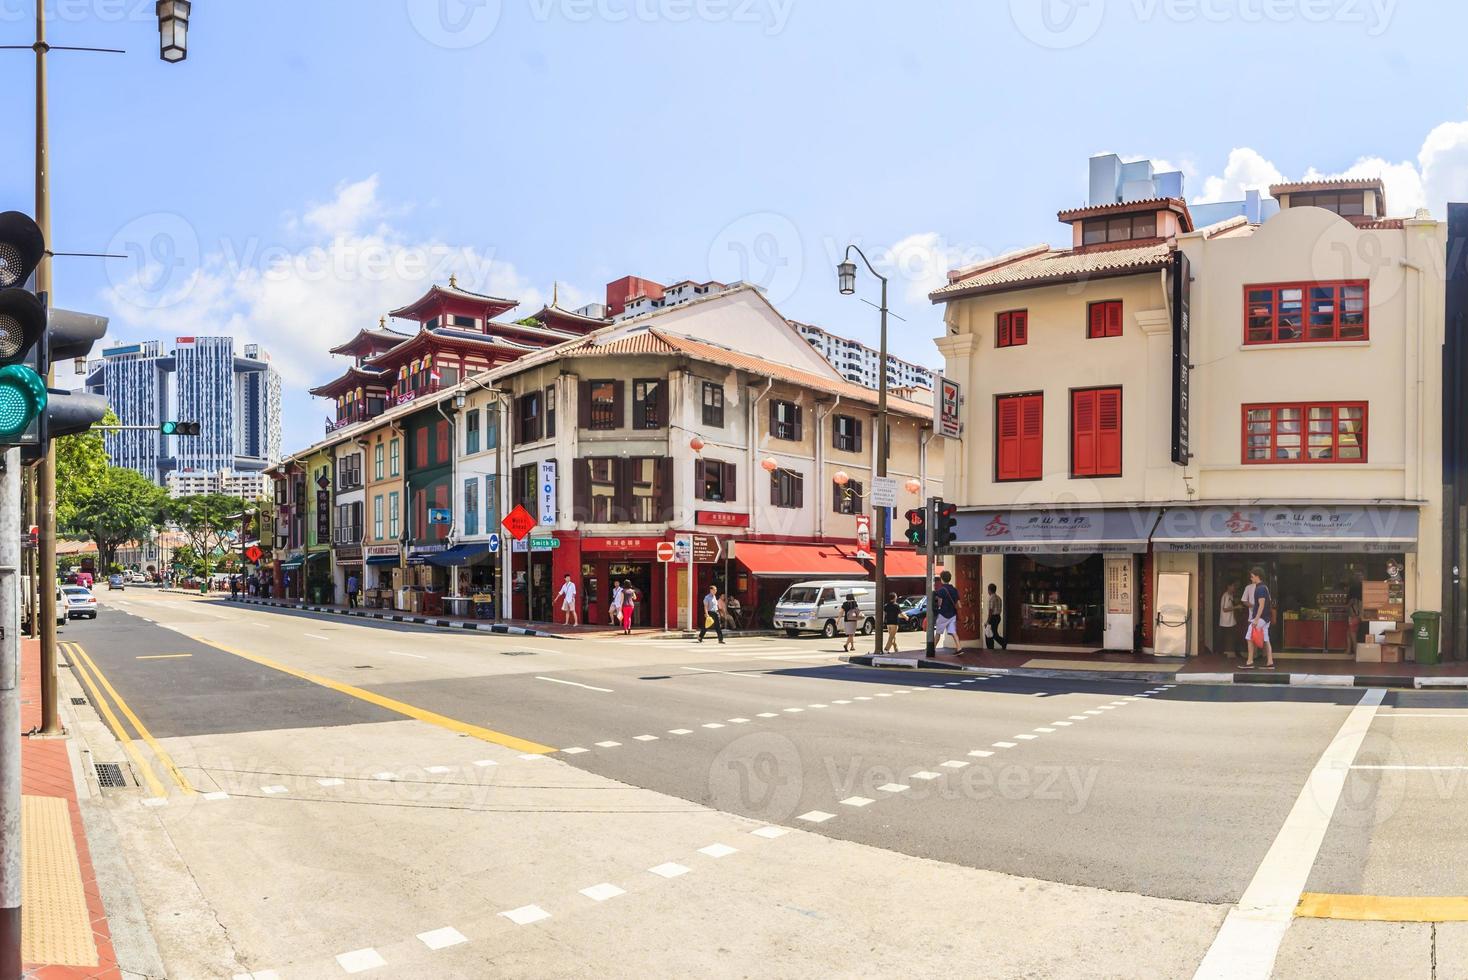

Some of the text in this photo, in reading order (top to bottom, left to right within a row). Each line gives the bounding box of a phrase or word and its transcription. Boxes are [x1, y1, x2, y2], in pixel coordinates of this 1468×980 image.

[944, 386, 956, 400] 7
[544, 474, 552, 513] LOFT
[1169, 543, 1184, 551] Thye
